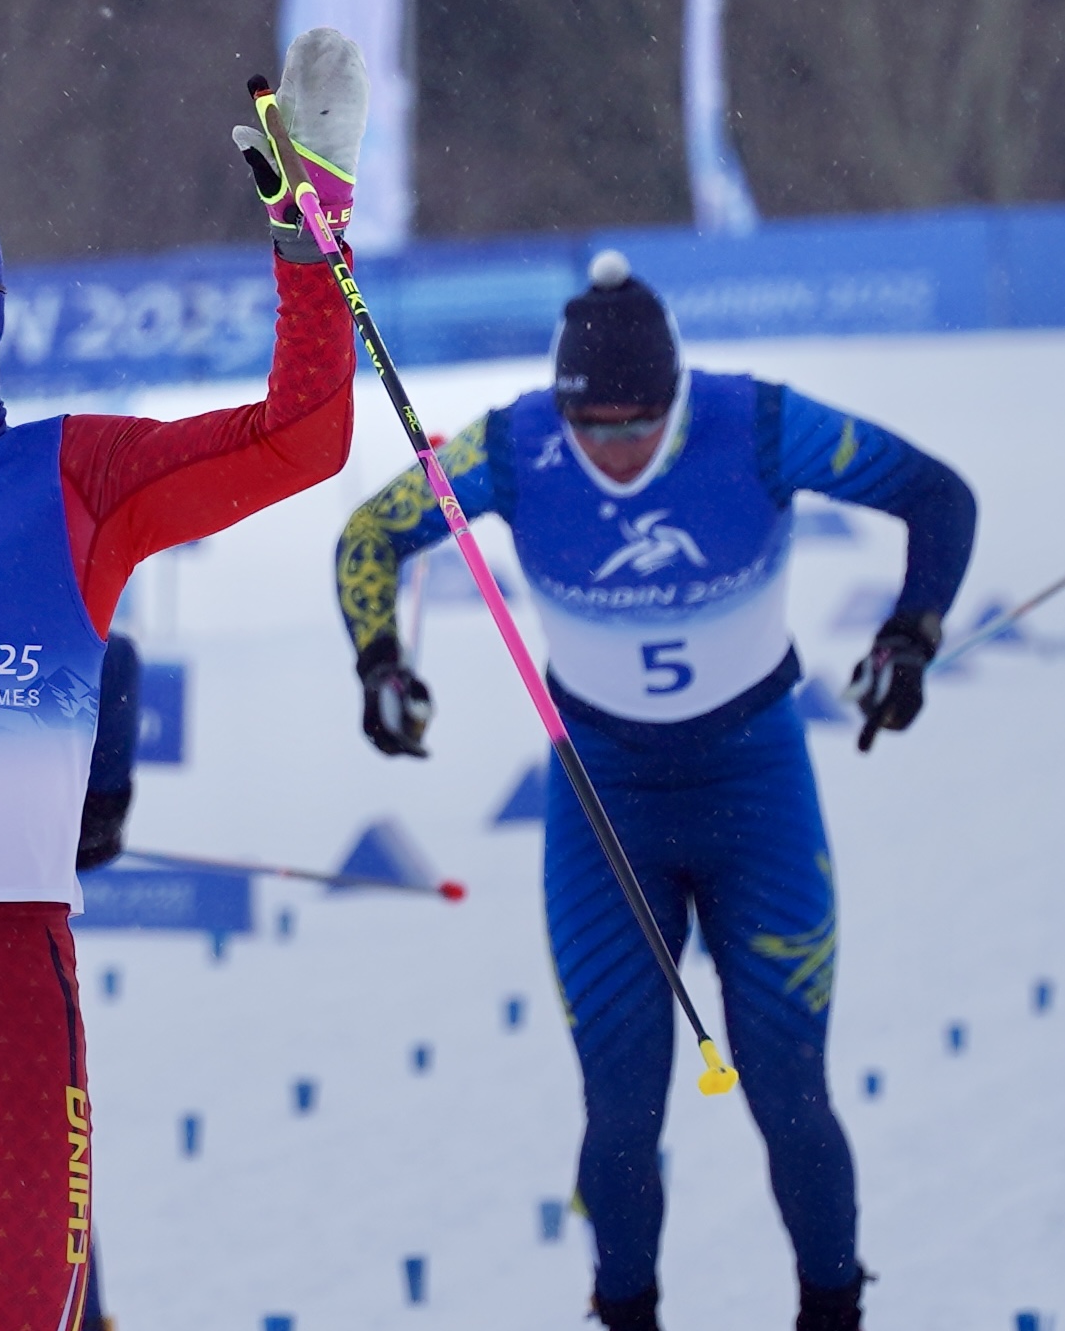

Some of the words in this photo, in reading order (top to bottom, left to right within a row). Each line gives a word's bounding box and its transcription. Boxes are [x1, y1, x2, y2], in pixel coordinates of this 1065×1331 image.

[333, 263, 369, 315] LEKI
[641, 638, 694, 695] 5
[65, 1085, 89, 1265] CHINA
